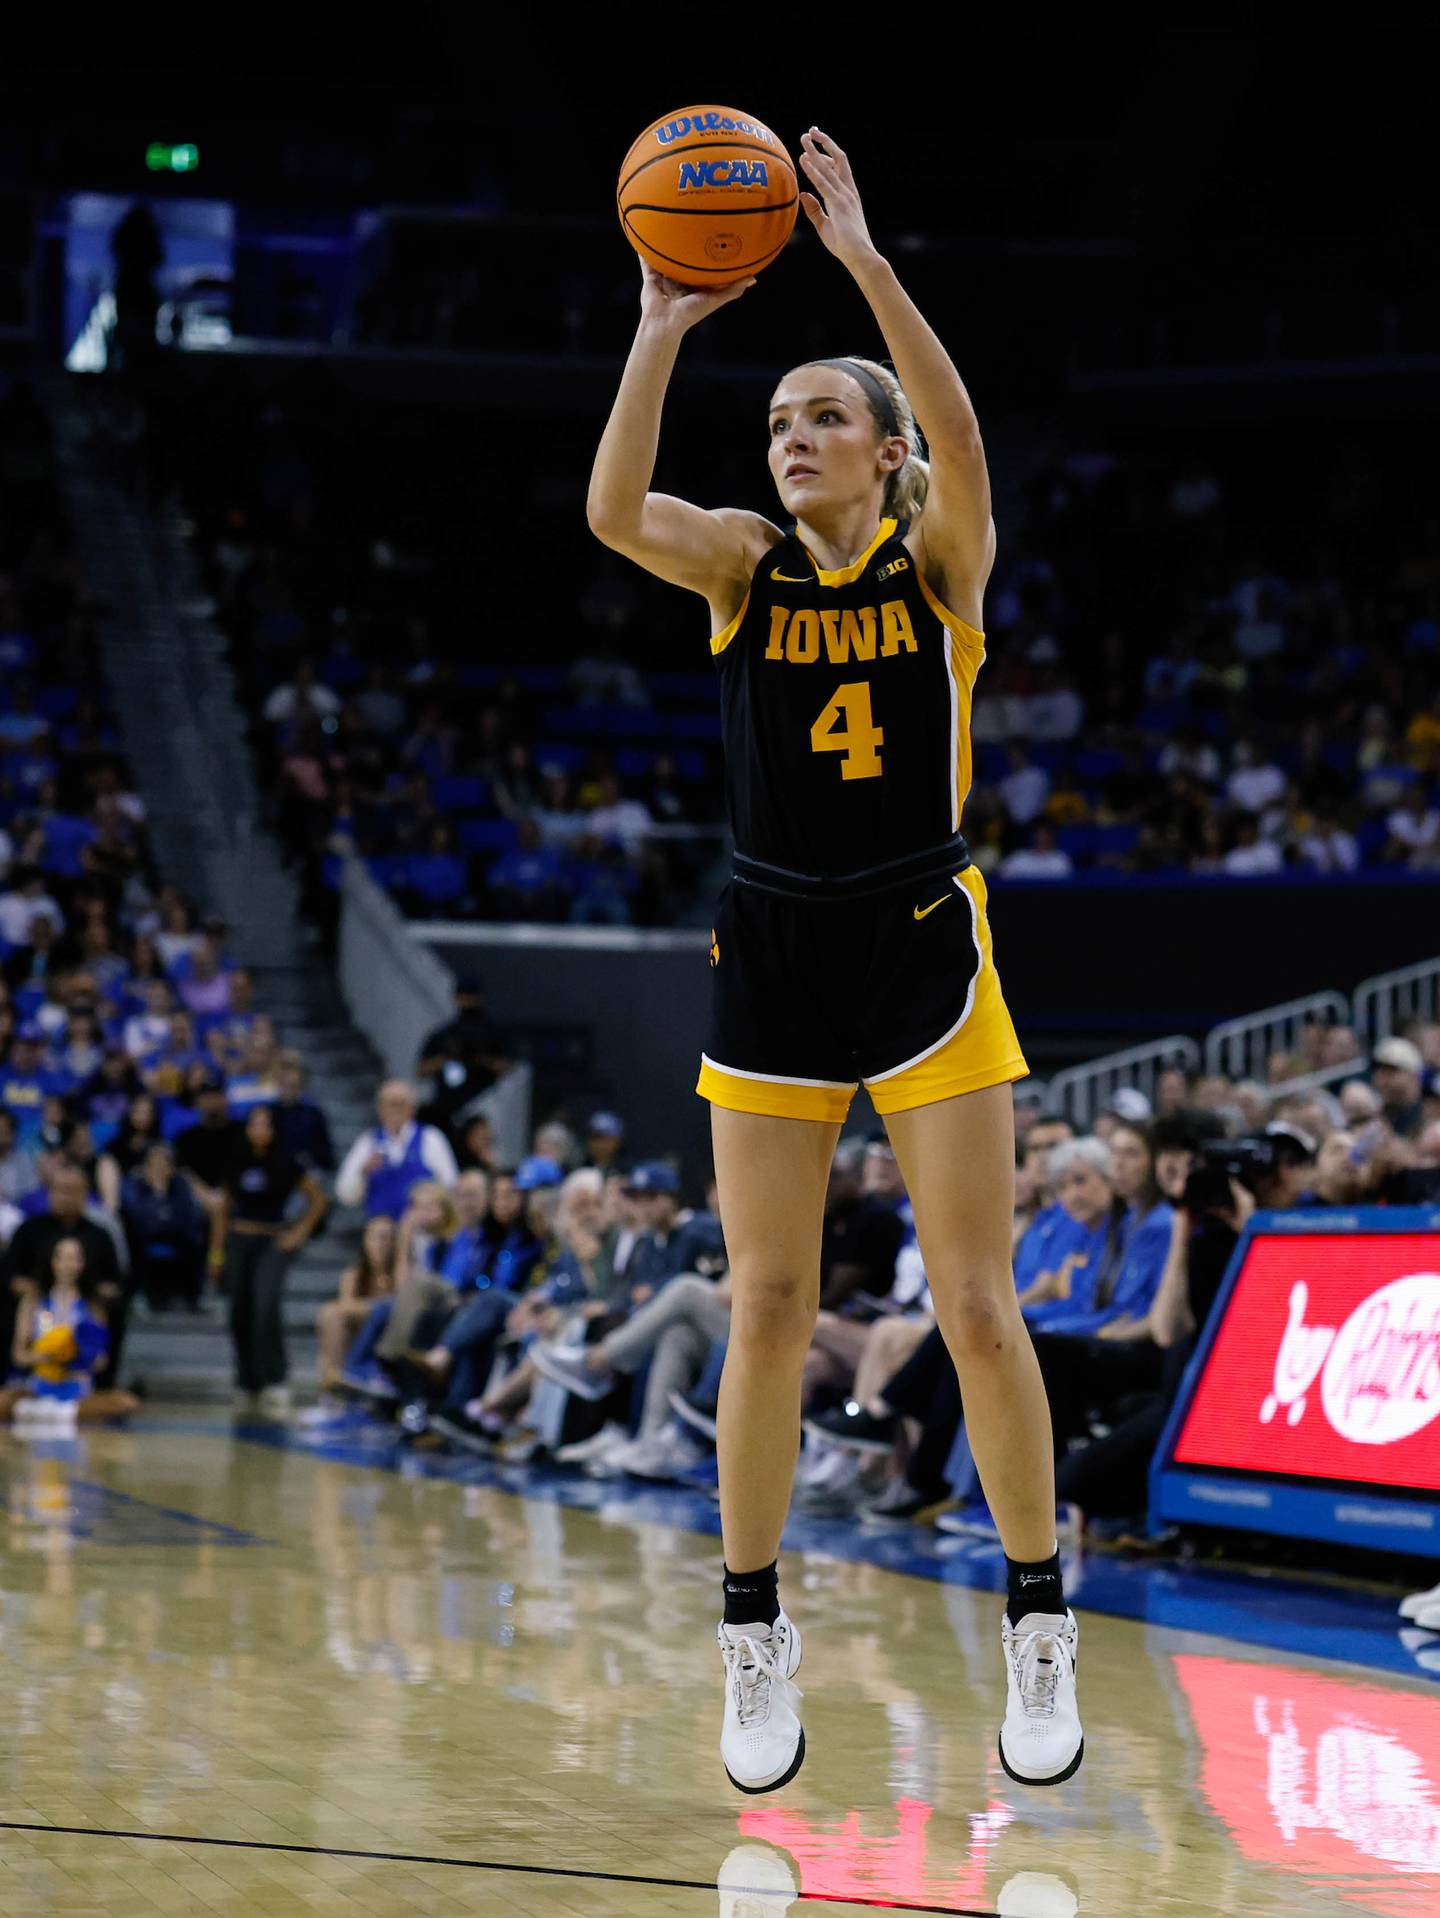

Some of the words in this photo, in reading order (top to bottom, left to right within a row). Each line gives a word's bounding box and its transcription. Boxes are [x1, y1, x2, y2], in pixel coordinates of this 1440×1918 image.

[653, 112, 774, 145] Wilson
[678, 159, 768, 190] NCAA
[765, 600, 918, 664] IOWA
[810, 681, 884, 780] 4
